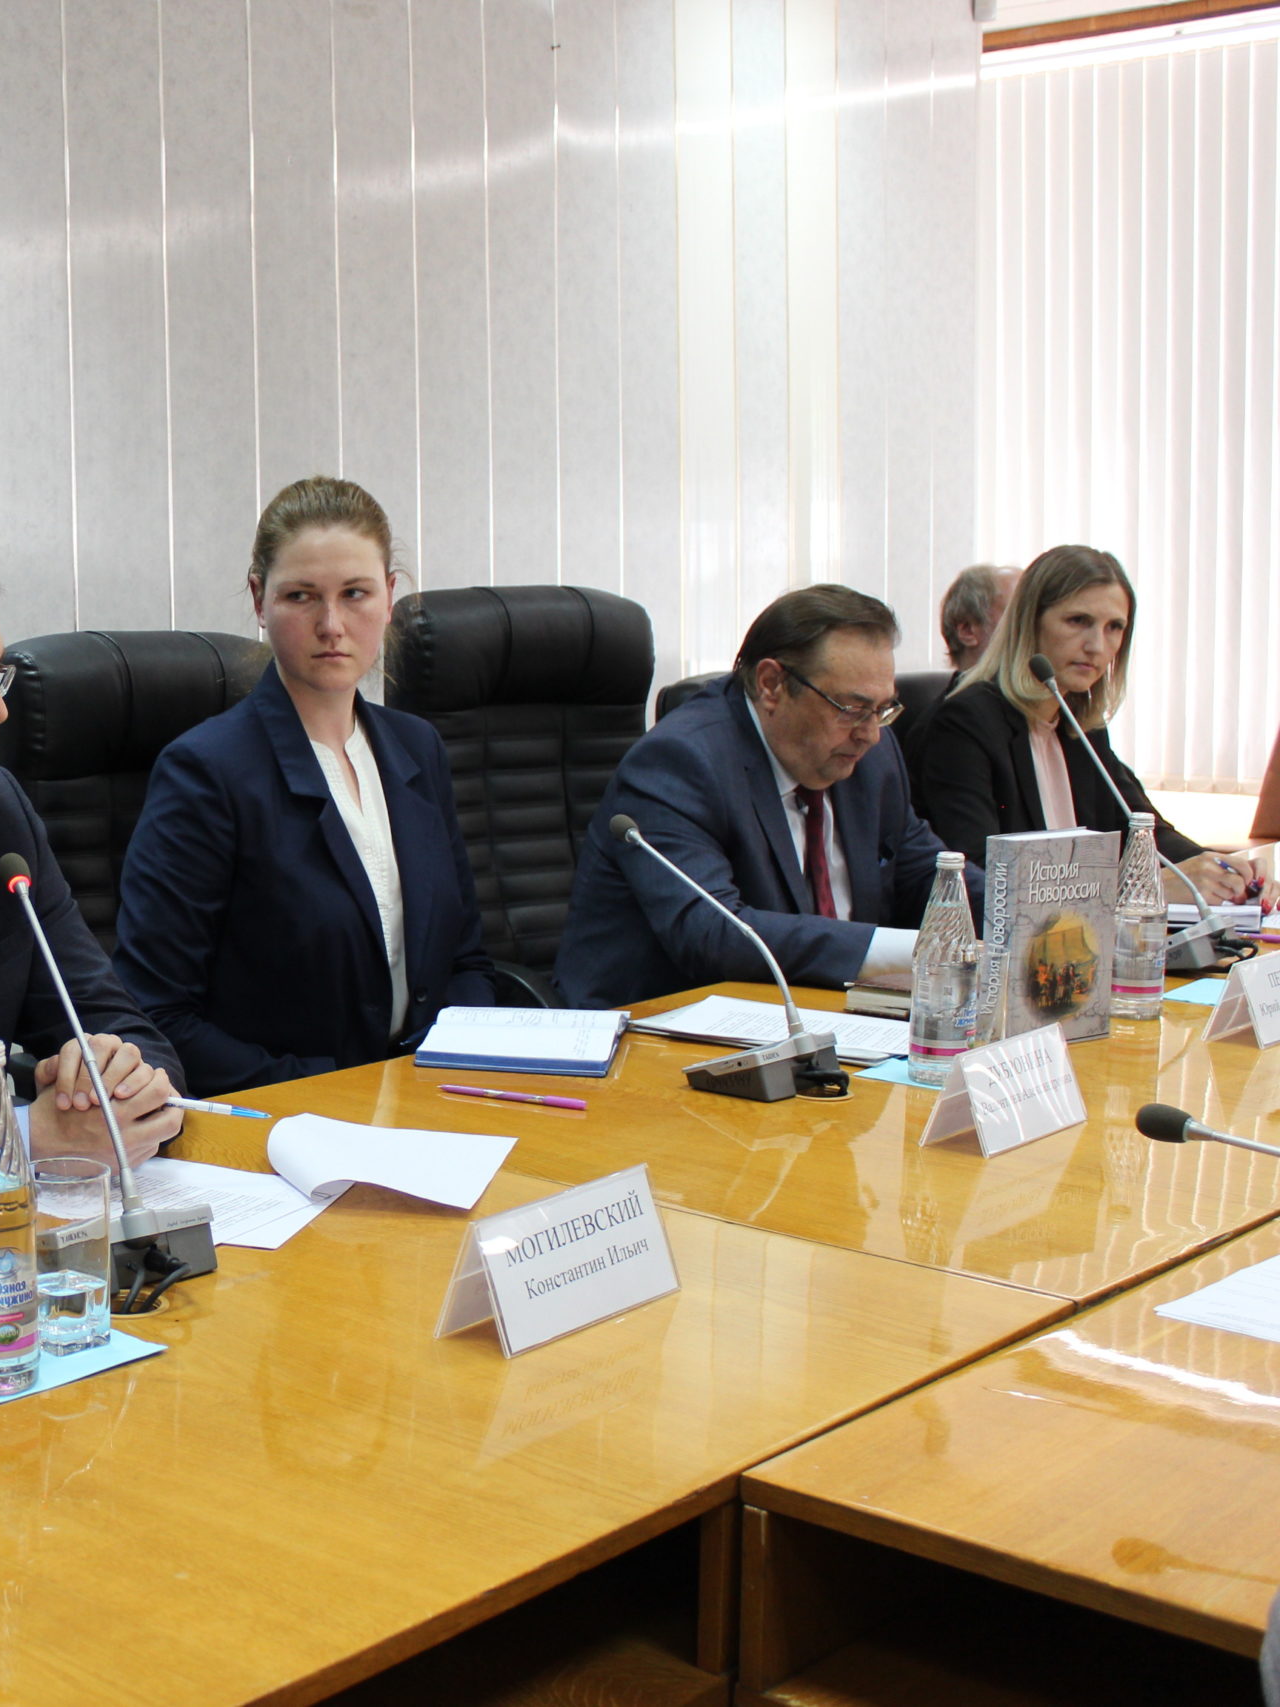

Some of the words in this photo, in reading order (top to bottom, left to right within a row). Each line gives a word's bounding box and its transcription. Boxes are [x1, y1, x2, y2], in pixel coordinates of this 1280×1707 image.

[1028, 882, 1101, 906] Новороссии
[1029, 860, 1080, 885] История
[505, 1189, 644, 1268] МОГИЛЕВСКИЙ
[524, 1255, 607, 1299] Константин
[606, 1238, 650, 1267] Ильич
